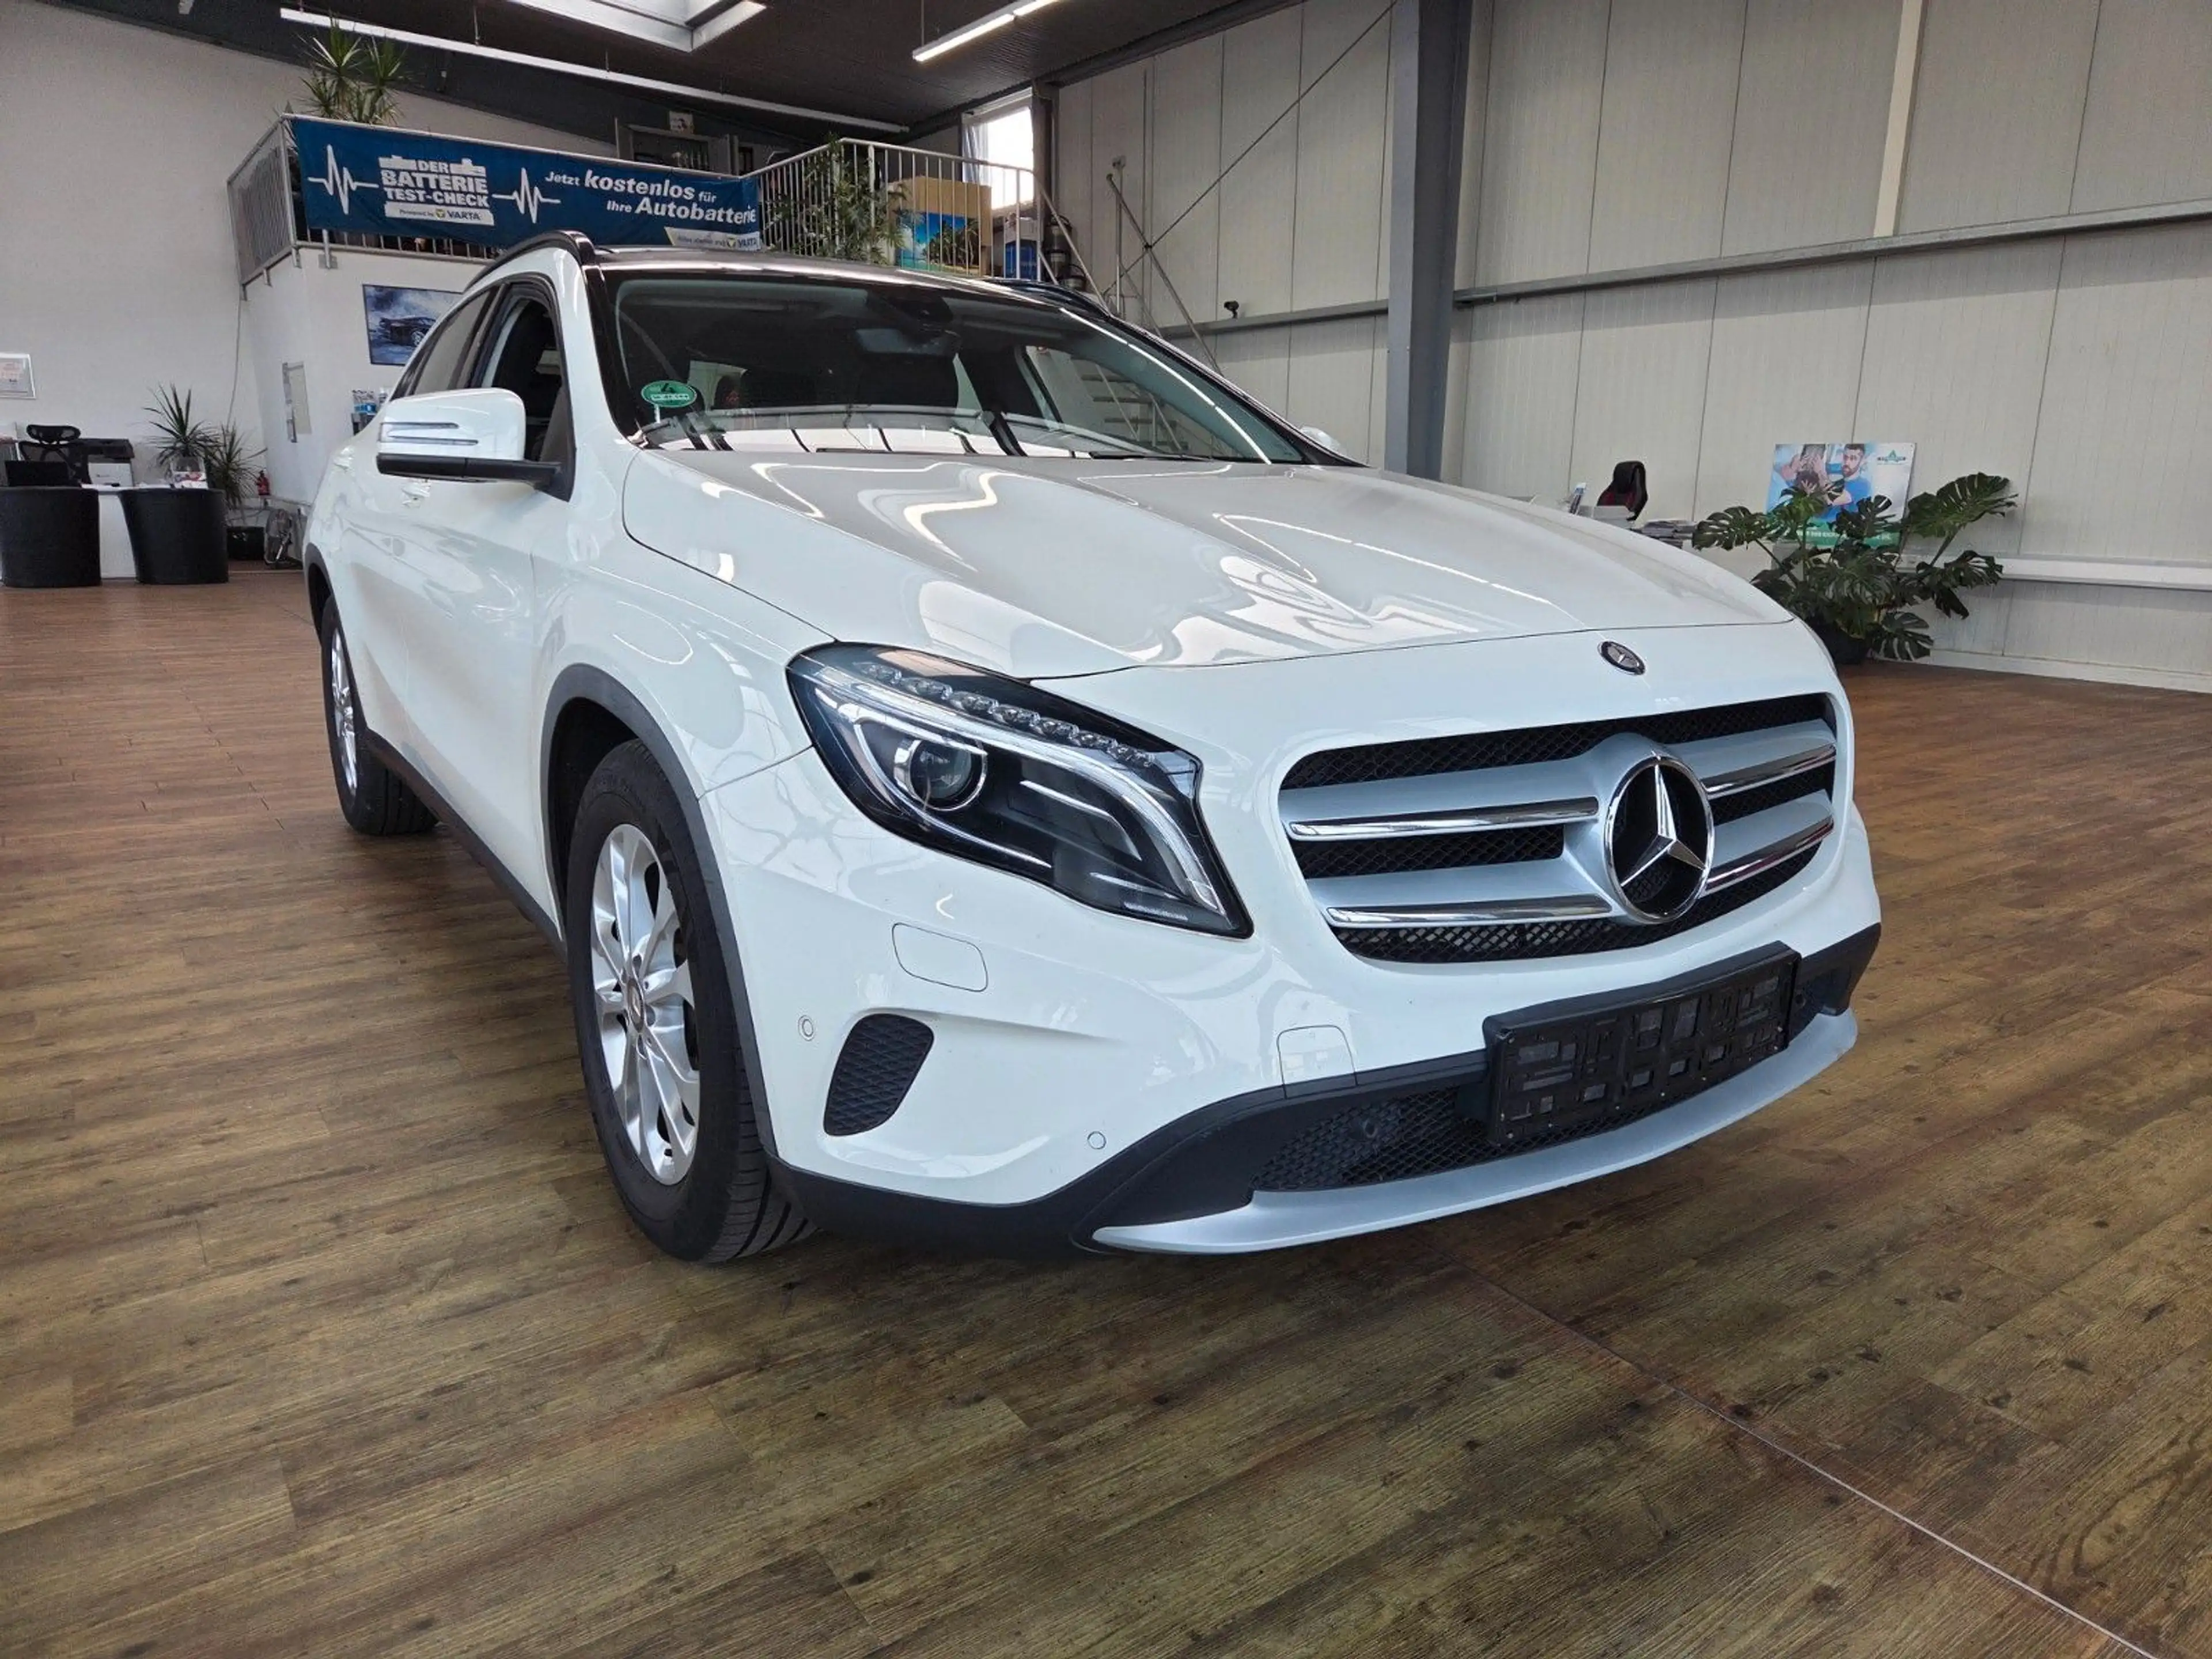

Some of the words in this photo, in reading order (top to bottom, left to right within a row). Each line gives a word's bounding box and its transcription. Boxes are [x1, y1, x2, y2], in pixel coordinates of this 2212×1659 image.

[418, 160, 449, 173] DER
[381, 170, 488, 194] BATTERIE
[545, 172, 580, 186] Jetzt
[585, 169, 695, 200] kostenlos
[698, 191, 717, 203] für
[384, 187, 489, 207] TEST-CHECK
[447, 210, 482, 220] VARTA
[607, 200, 632, 213] Ihre
[635, 197, 757, 225] Autobatterie
